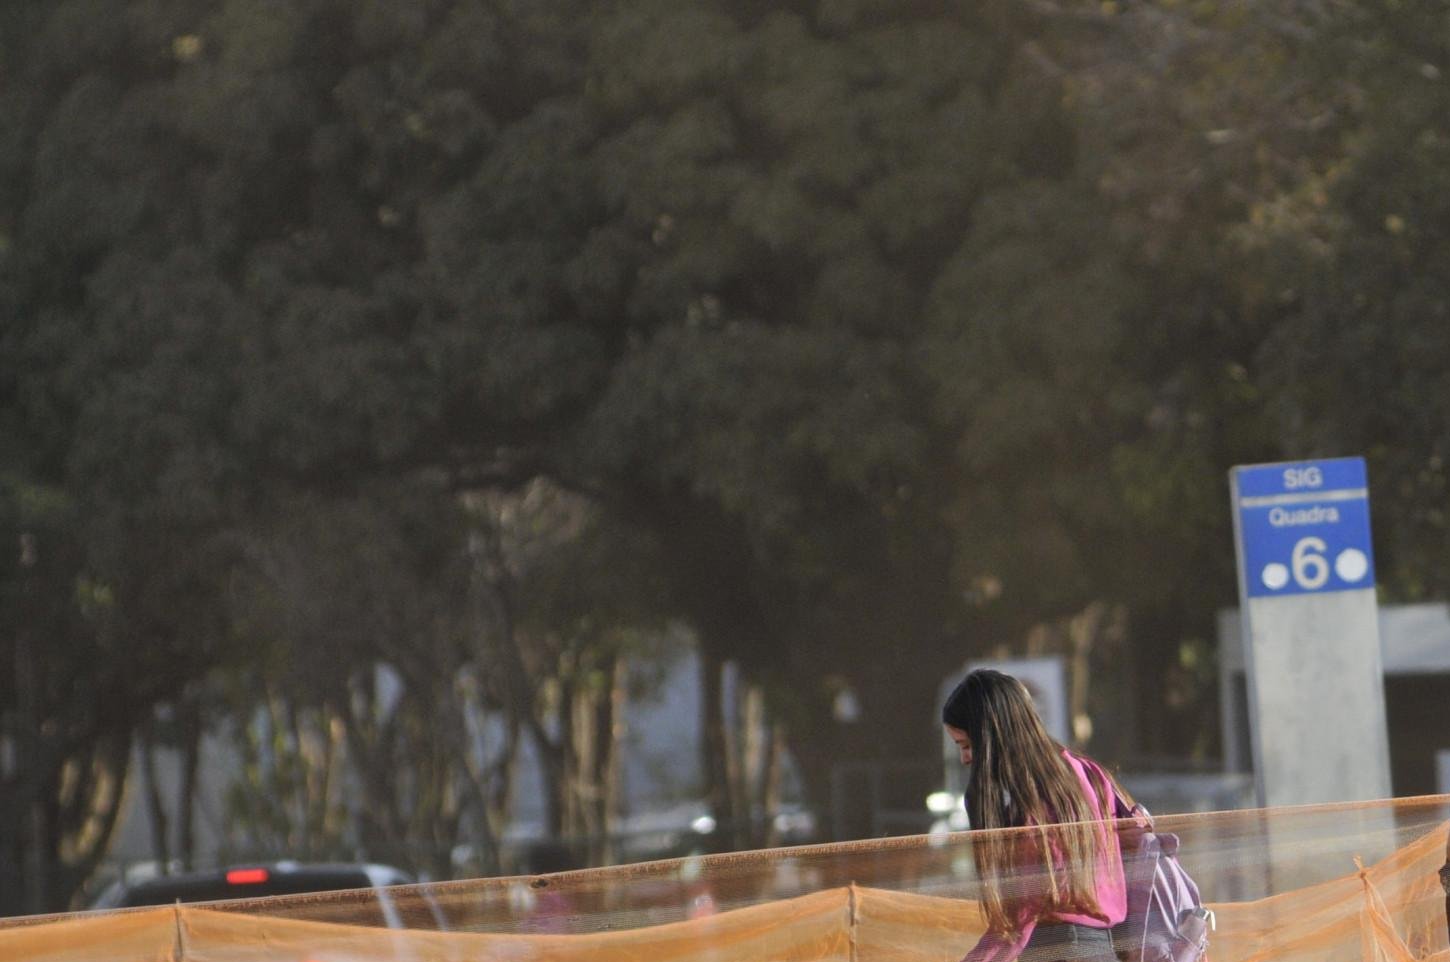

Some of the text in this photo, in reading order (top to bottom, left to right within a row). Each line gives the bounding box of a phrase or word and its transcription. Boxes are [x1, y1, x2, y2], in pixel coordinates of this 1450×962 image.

[1283, 466, 1323, 489] SIG
[1268, 506, 1340, 528] Quadra
[1291, 536, 1330, 590] 6
